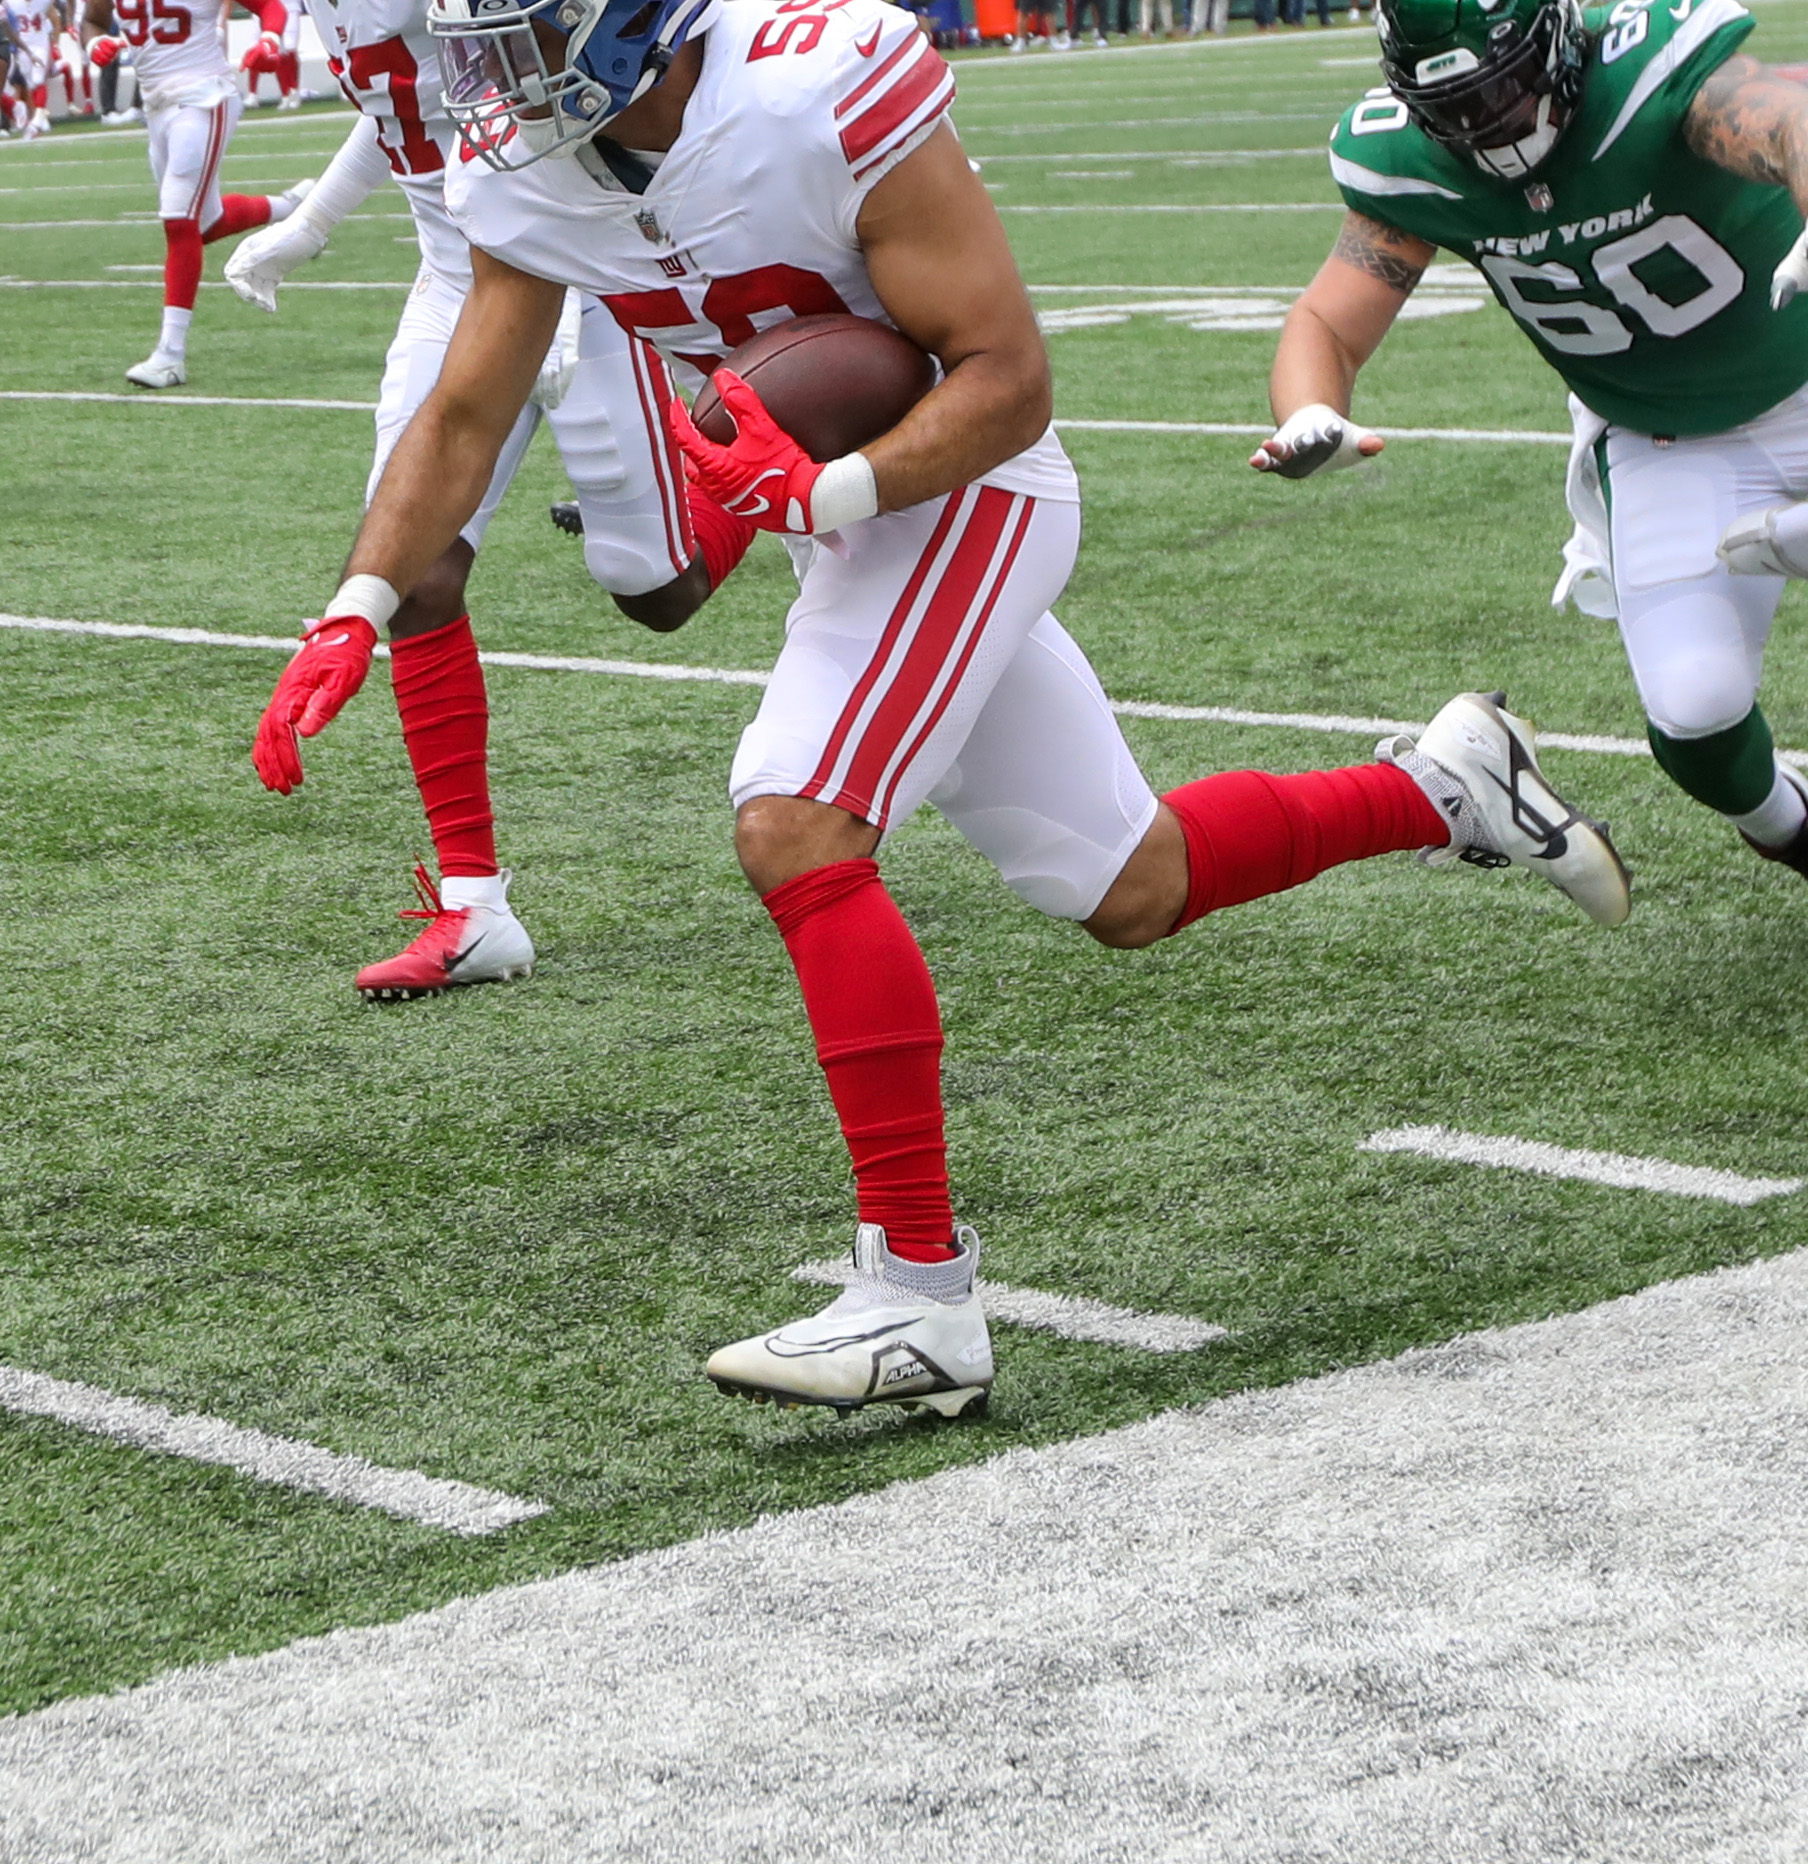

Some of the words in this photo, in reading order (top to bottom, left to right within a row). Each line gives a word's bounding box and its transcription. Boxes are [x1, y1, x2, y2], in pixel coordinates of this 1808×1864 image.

[1474, 233, 1548, 258] NEW
[1558, 193, 1653, 243] YORK
[1481, 213, 1747, 357] 60
